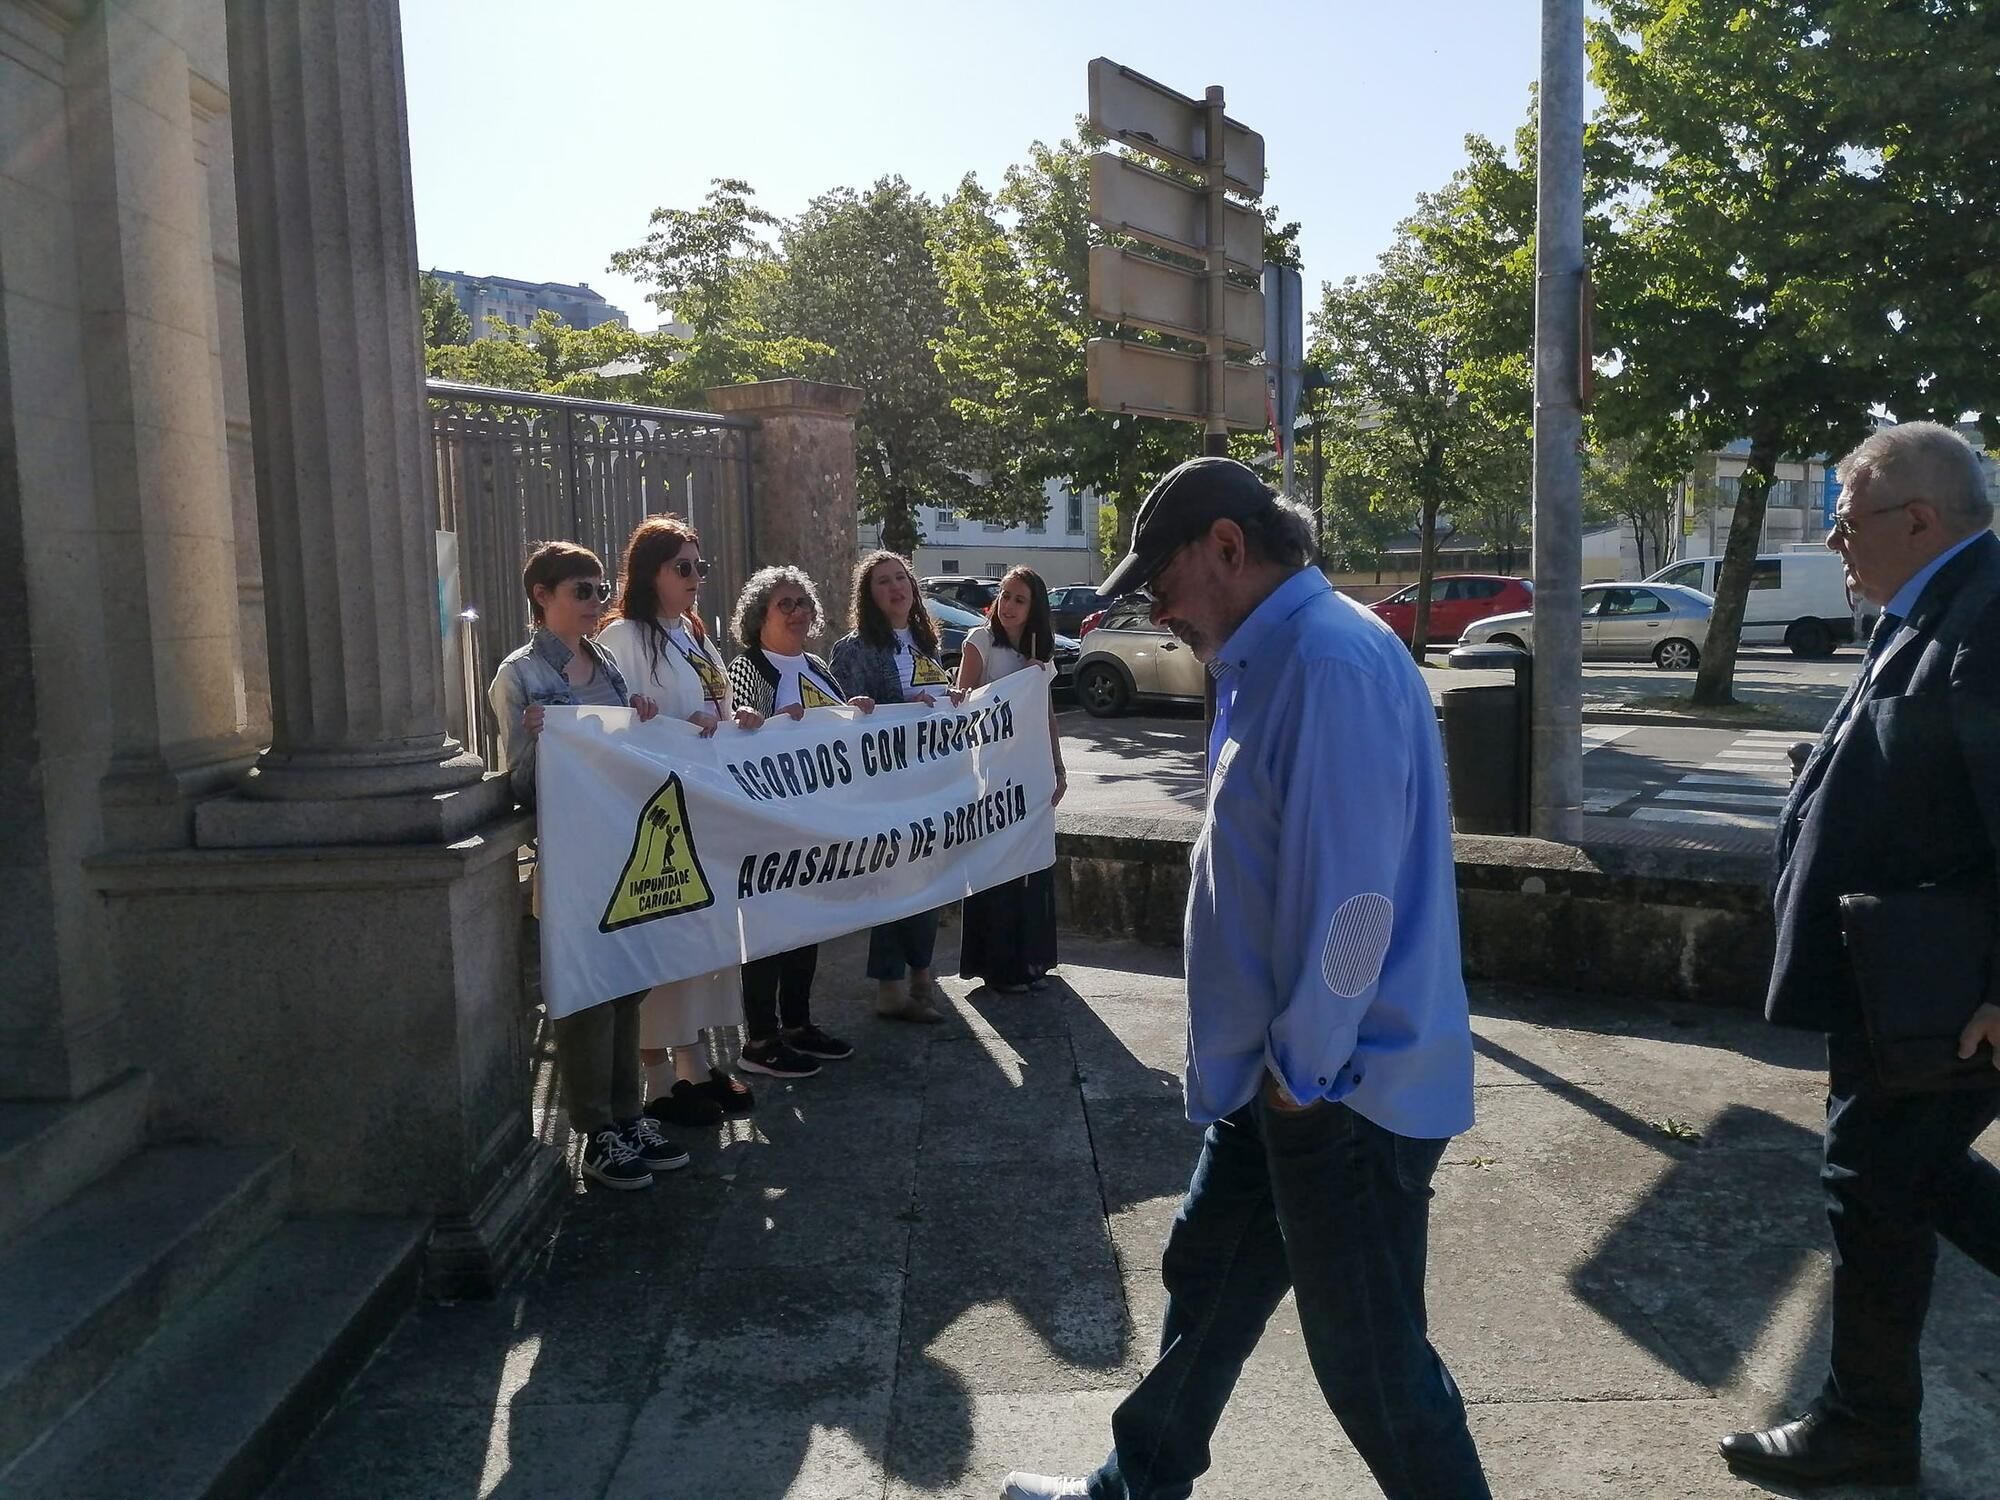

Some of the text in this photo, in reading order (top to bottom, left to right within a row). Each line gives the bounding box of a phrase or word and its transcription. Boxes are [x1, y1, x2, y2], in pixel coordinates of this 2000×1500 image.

[727, 695, 1014, 800] ACORDOS CON FISCALÍA
[738, 778, 1027, 899] AGASALLOS DE CORTESÍA
[630, 868, 690, 897] IMPUNIDADE
[639, 888, 682, 912] CARIOCA
